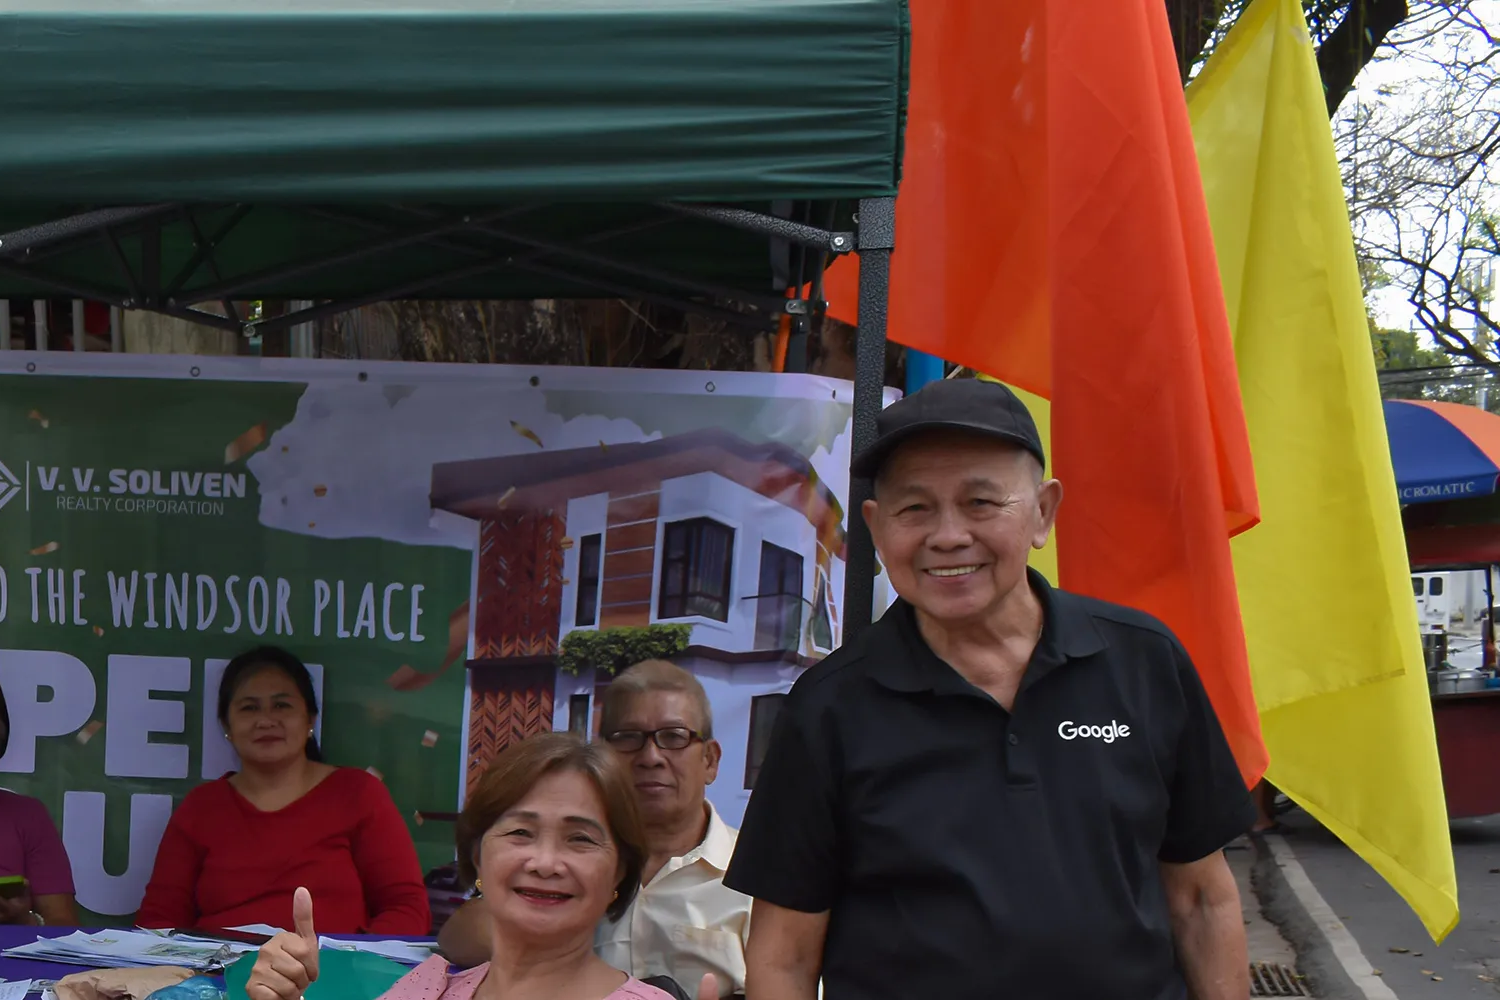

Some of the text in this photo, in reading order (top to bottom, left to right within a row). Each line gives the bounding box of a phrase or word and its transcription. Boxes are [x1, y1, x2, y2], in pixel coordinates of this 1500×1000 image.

[37, 466, 246, 498] V. V. SOLIVEN
[1399, 481, 1476, 499] ICROMATIC
[56, 495, 225, 516] REALTY CORPORATION
[24, 567, 88, 626] THE
[107, 569, 294, 636] WINDSOR
[313, 578, 426, 642] PLACE
[1057, 719, 1131, 744] Google
